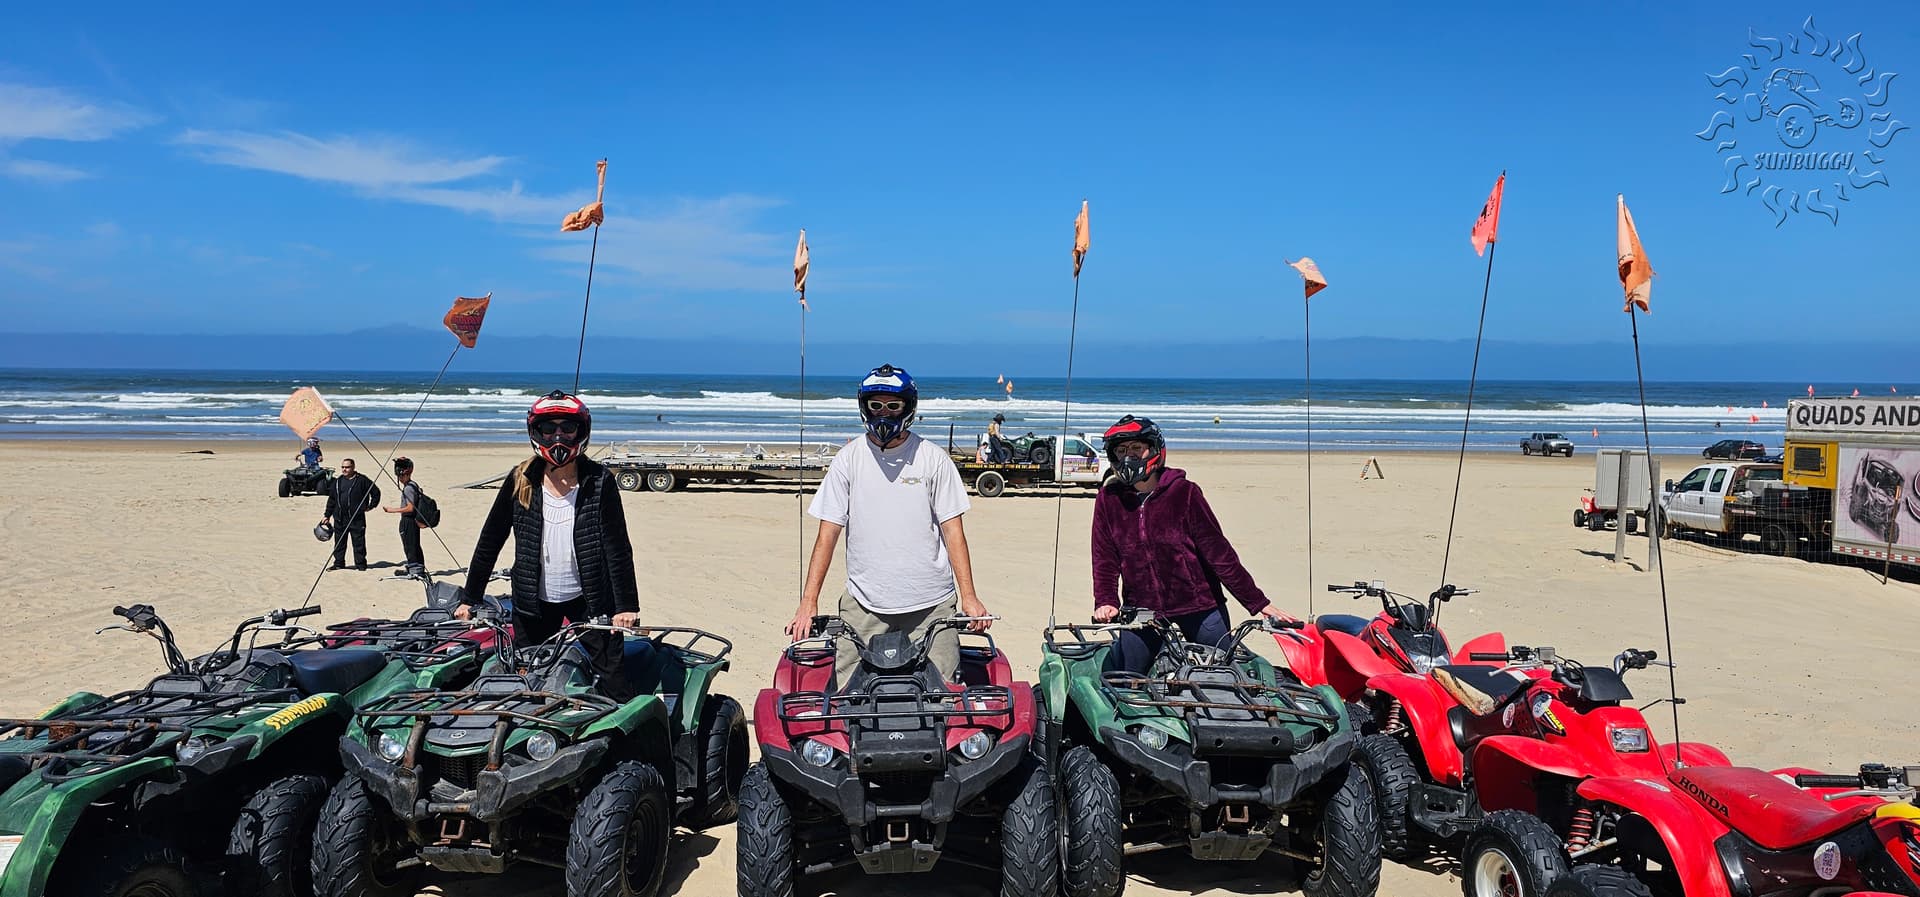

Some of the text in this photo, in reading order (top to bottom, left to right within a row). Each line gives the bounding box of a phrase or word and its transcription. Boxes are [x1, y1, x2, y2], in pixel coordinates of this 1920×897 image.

[1796, 405, 1920, 426] QUADS AND
[1679, 775, 1730, 819] HONDA
